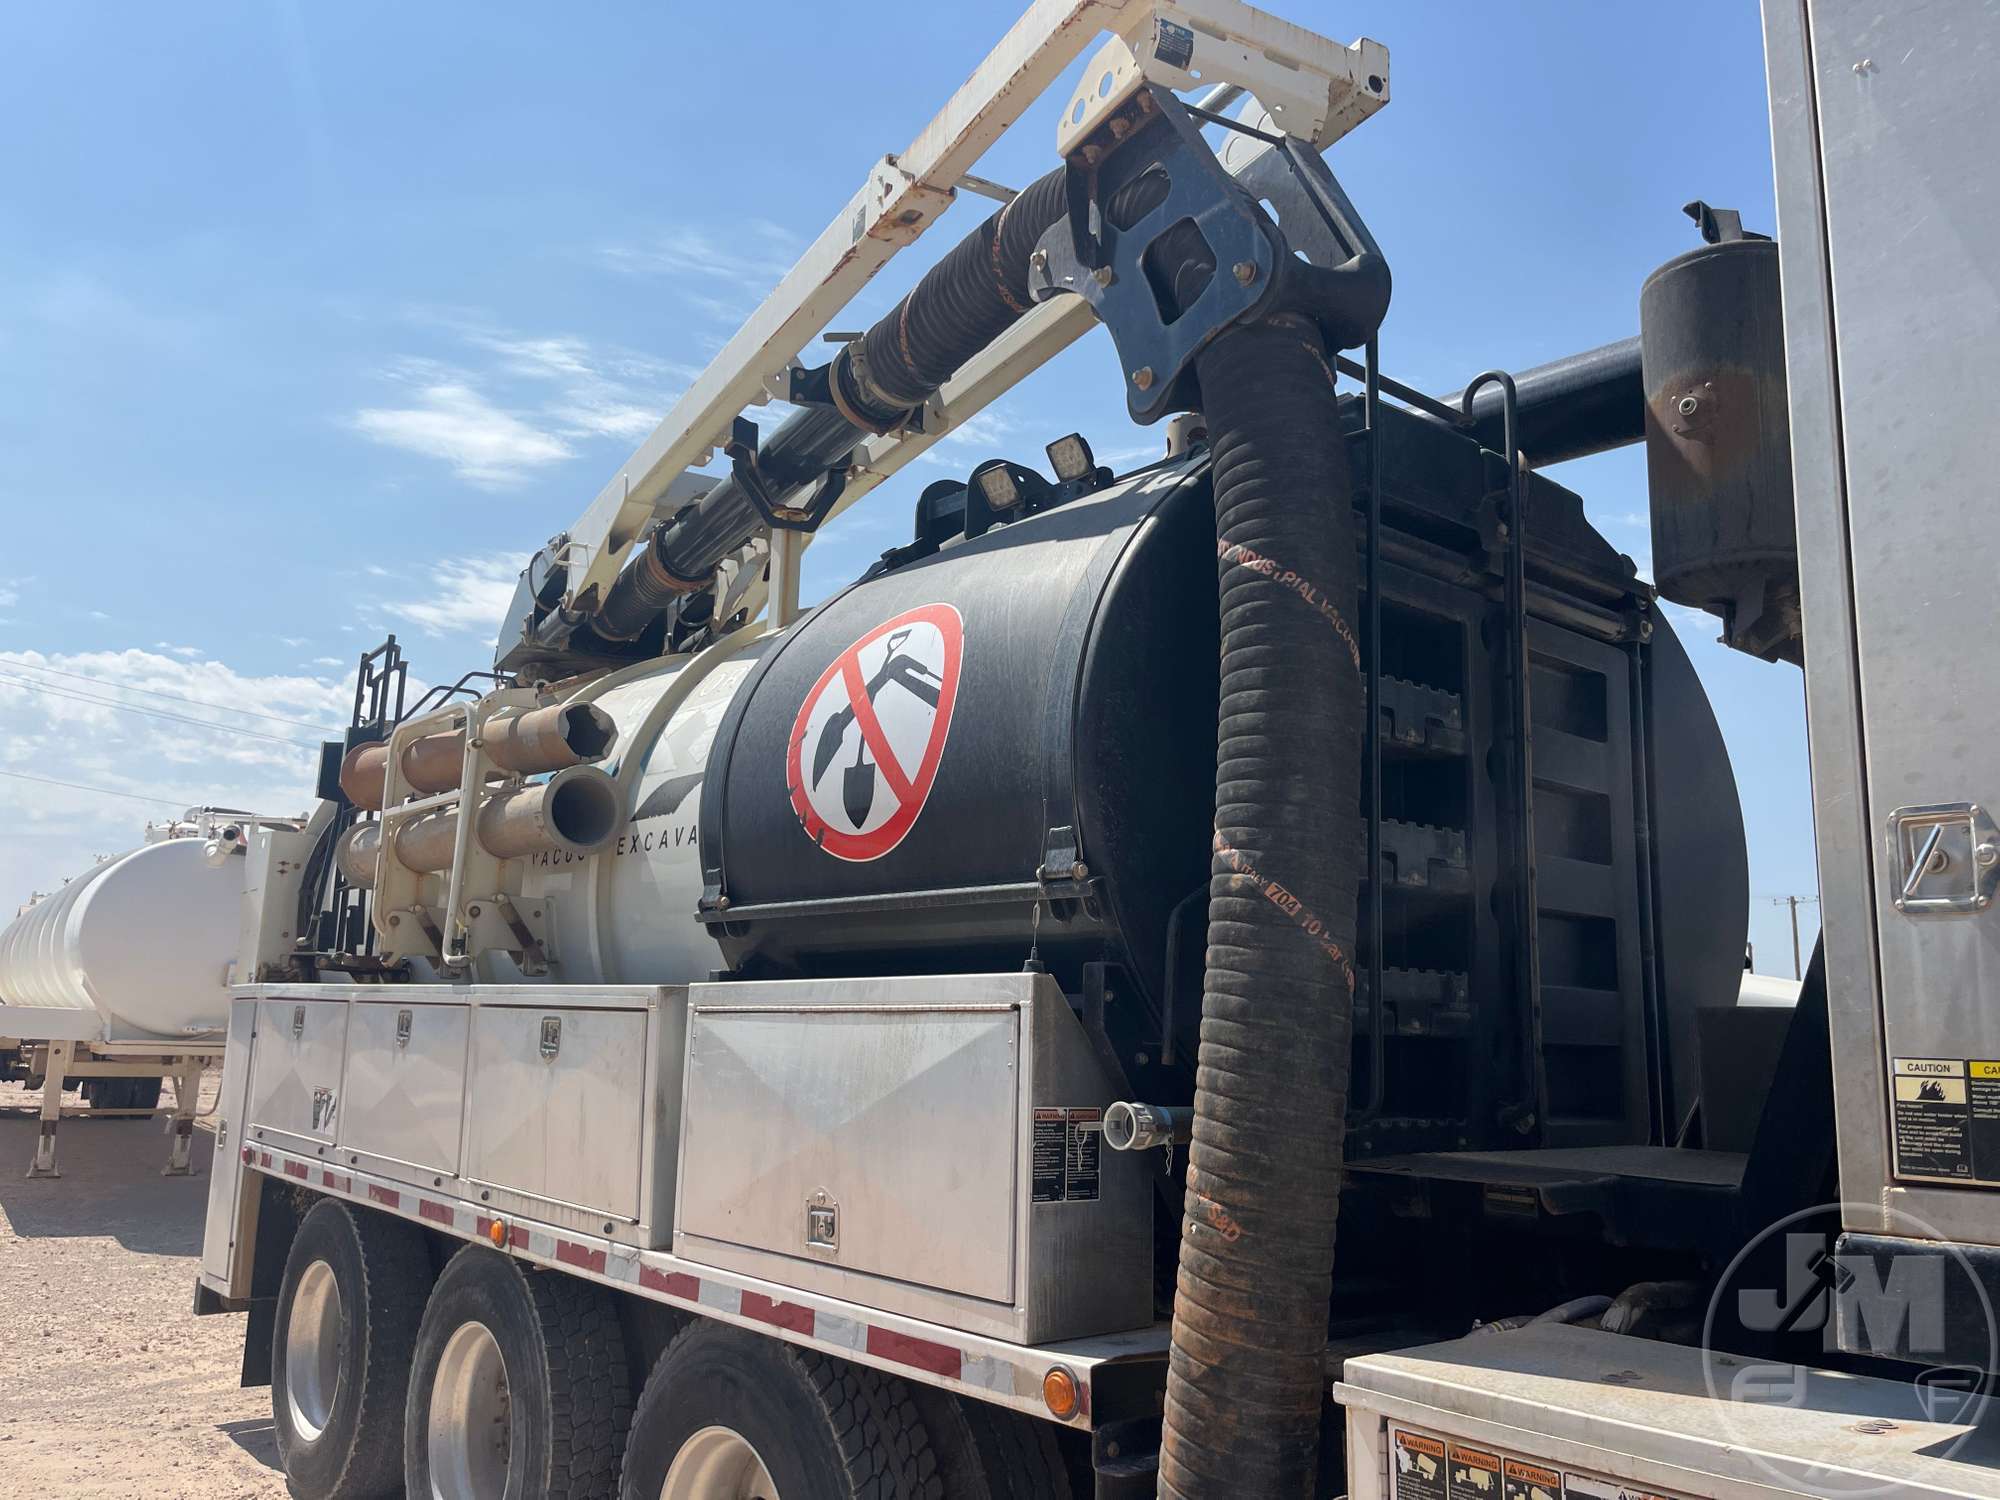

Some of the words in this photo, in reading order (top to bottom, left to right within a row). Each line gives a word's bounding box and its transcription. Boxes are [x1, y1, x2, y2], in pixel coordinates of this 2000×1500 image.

[616, 825, 698, 856] EXCAVA
[1269, 885, 1299, 912] 704
[1907, 1063, 1951, 1073] CAUTION
[1407, 1438, 1442, 1455] WARNING
[1459, 1454, 1498, 1471] WARNING
[1516, 1467, 1557, 1487] WARNING
